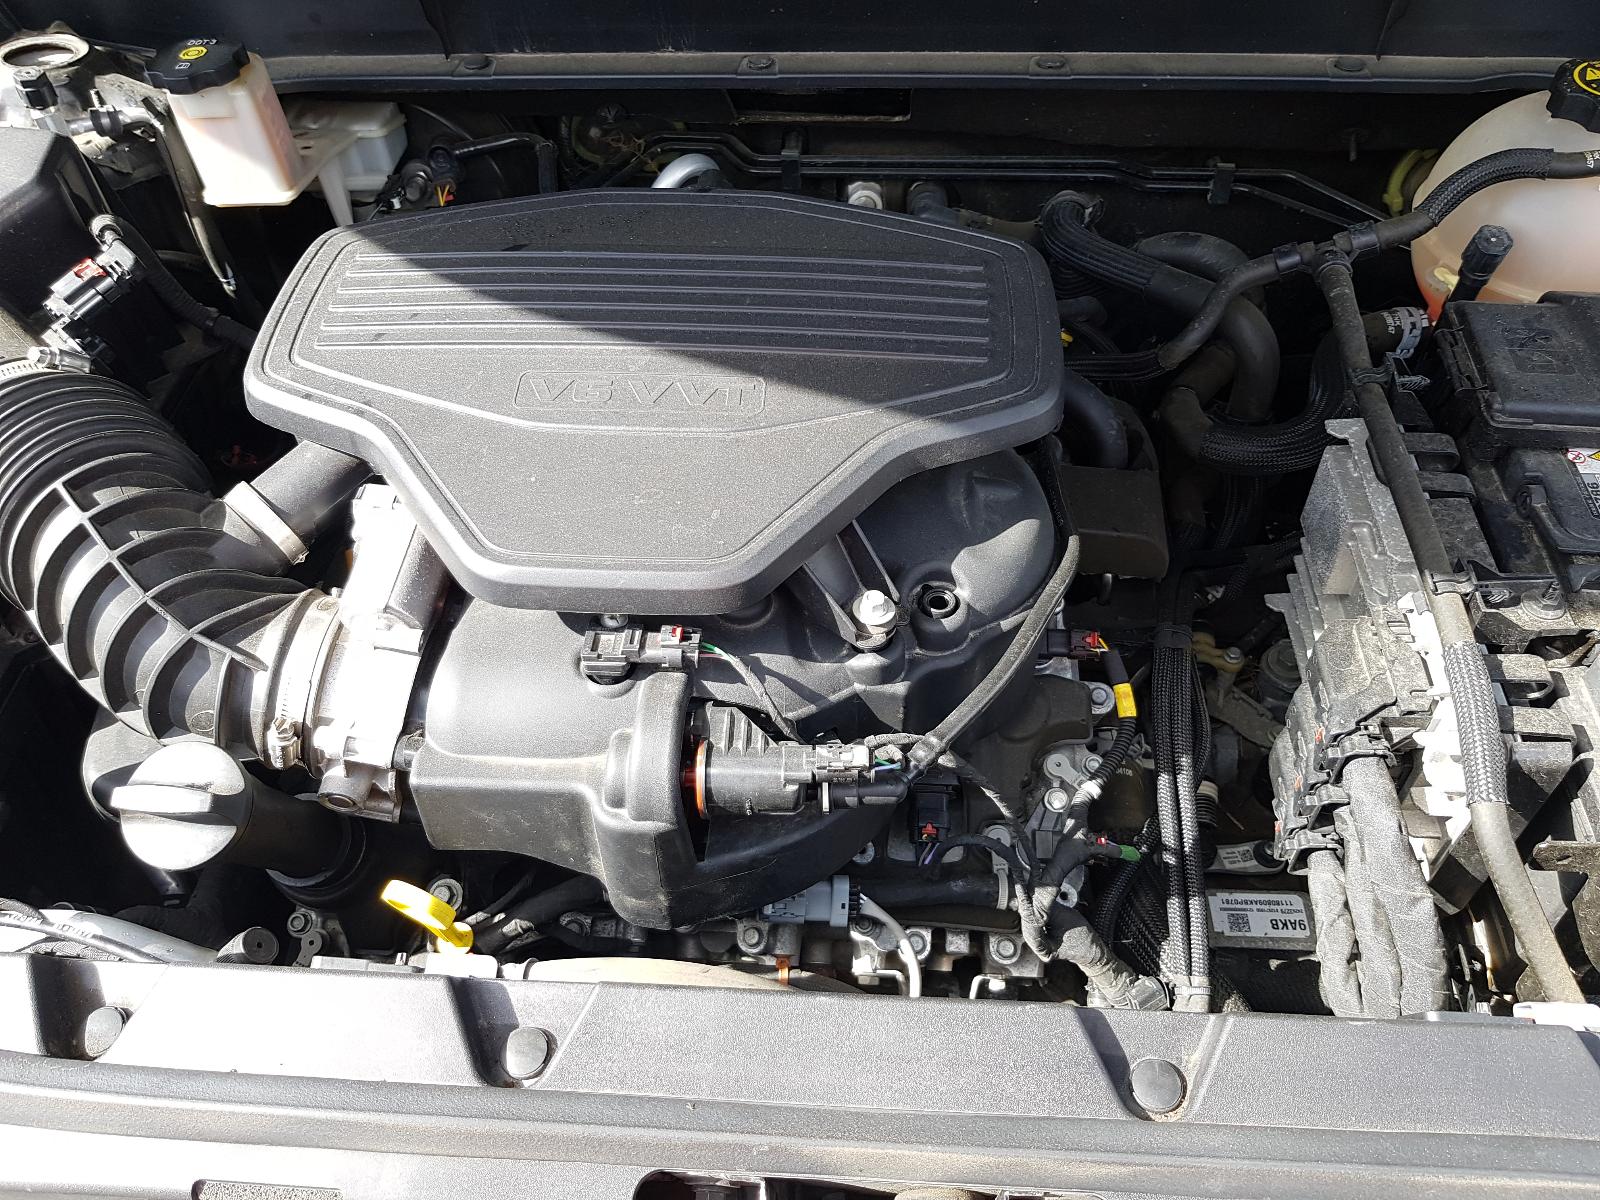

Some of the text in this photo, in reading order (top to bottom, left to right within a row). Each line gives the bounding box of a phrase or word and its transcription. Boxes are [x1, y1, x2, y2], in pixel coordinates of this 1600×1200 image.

[528, 378, 757, 406] V6 VVT
[1269, 918, 1307, 931] 9AKB
